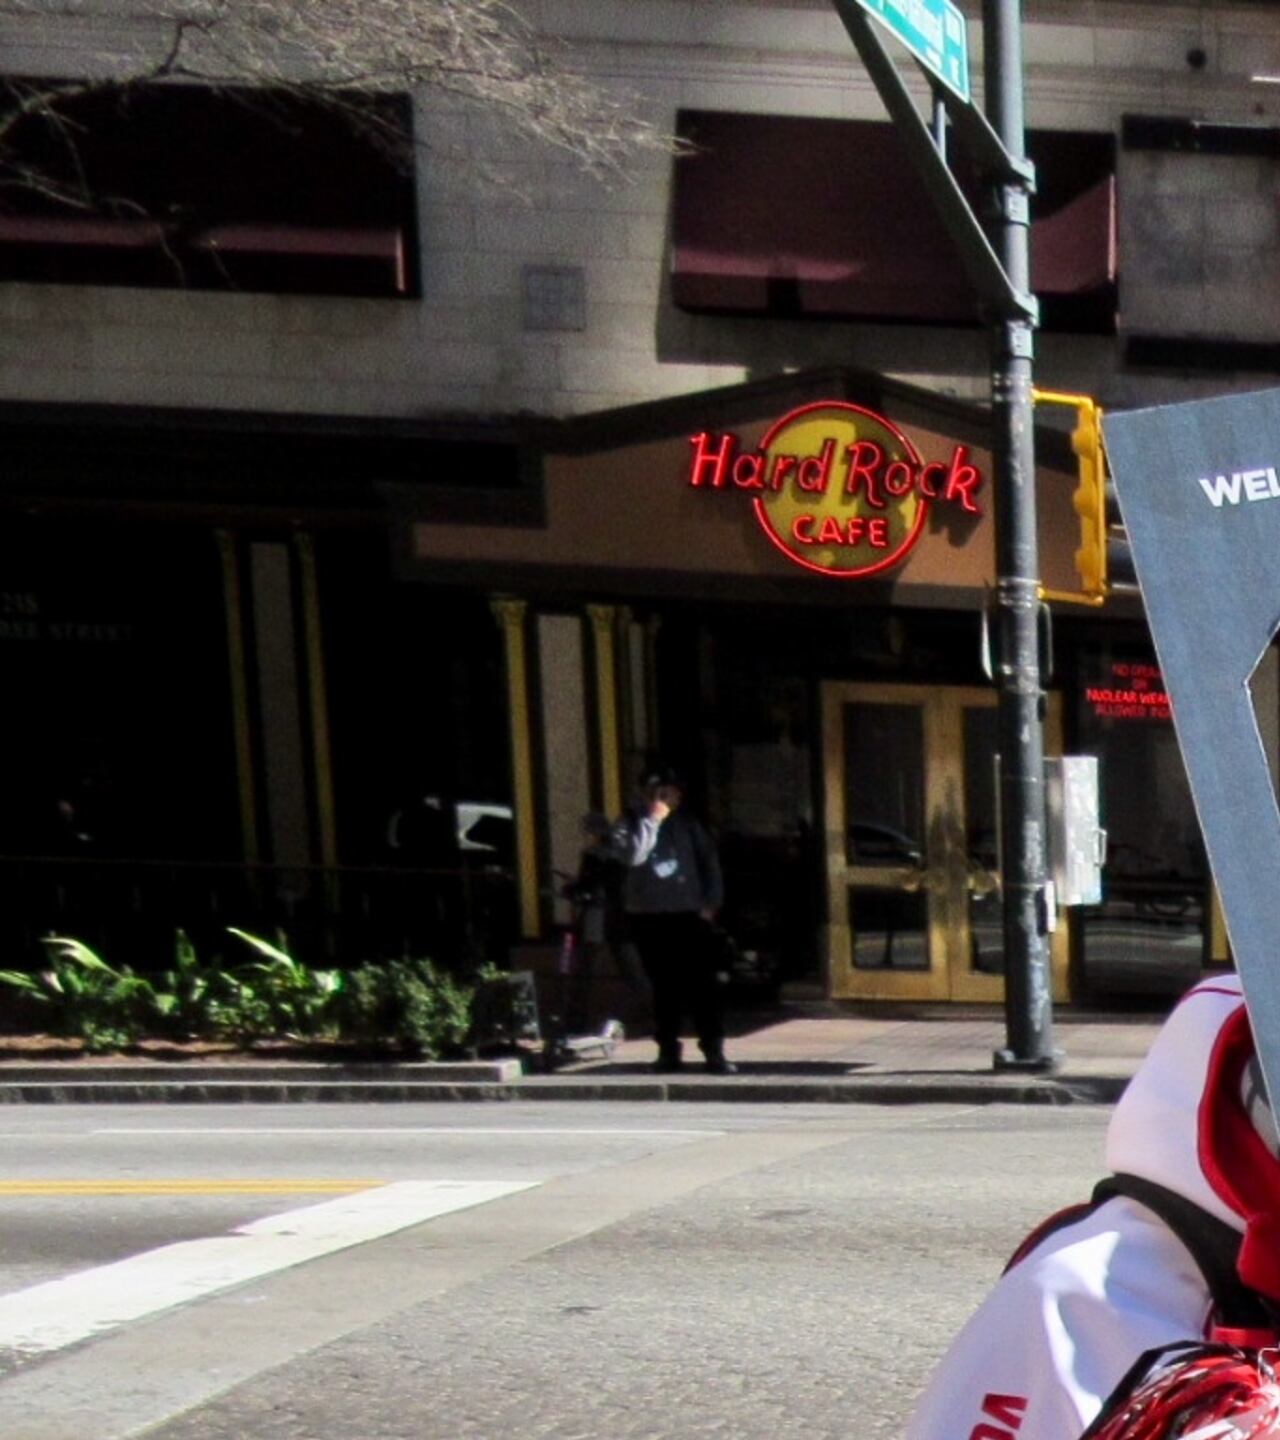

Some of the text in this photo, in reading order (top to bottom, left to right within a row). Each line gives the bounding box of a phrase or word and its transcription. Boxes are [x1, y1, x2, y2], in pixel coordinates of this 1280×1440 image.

[688, 431, 982, 512] Hard Rock
[791, 514, 888, 548] CAFE
[1086, 688, 1137, 702] NUCLEAR
